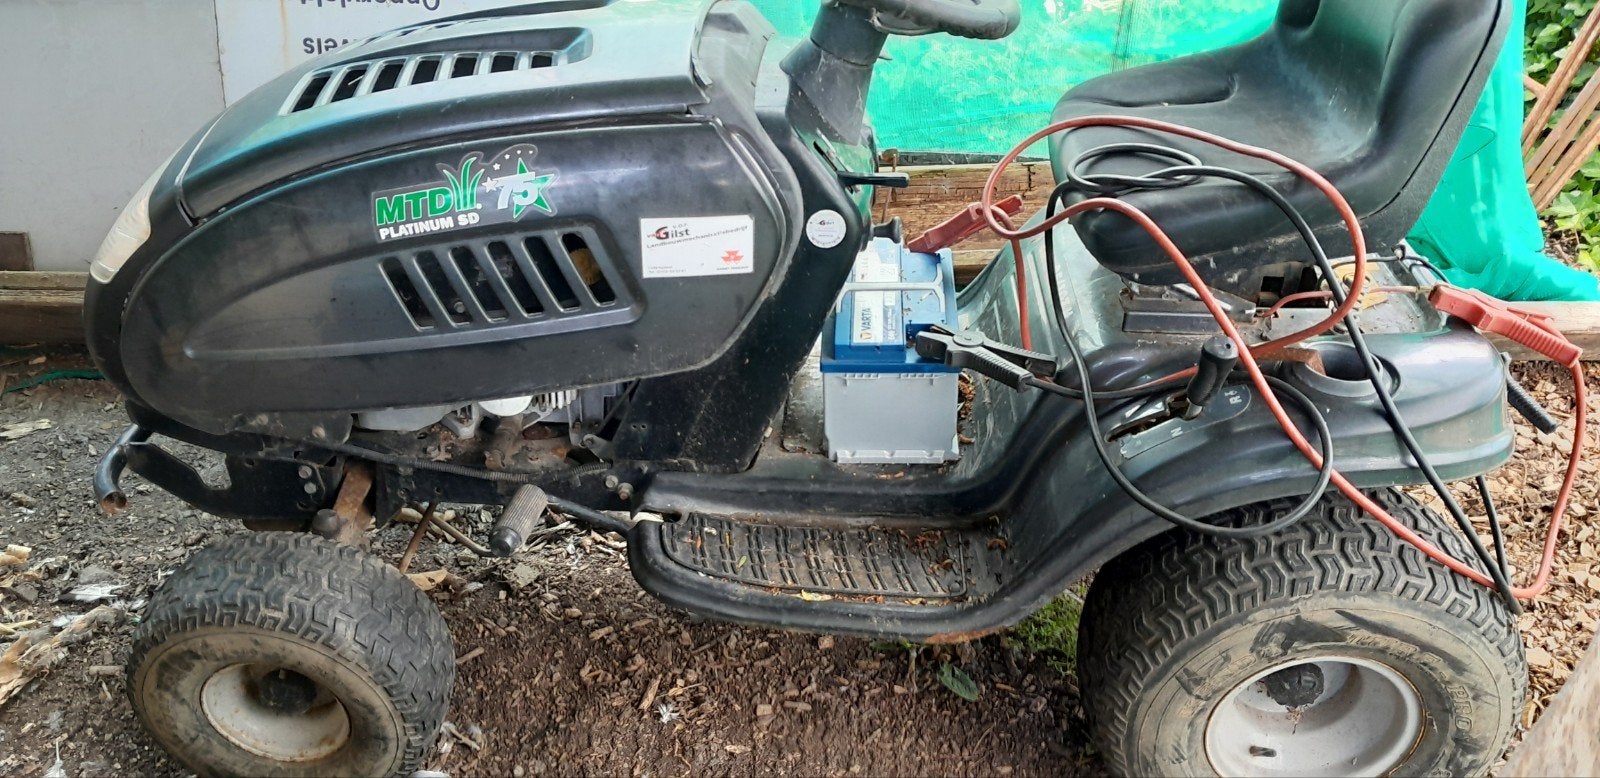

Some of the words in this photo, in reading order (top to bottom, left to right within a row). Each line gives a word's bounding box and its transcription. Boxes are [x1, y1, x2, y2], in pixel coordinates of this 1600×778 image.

[492, 172, 539, 209] 75
[376, 187, 454, 226] MTD
[379, 217, 454, 240] PLATINUM
[458, 212, 480, 226] SD
[655, 226, 691, 240] Gilst
[861, 308, 872, 331] VARTA
[1170, 426, 1184, 438] N
